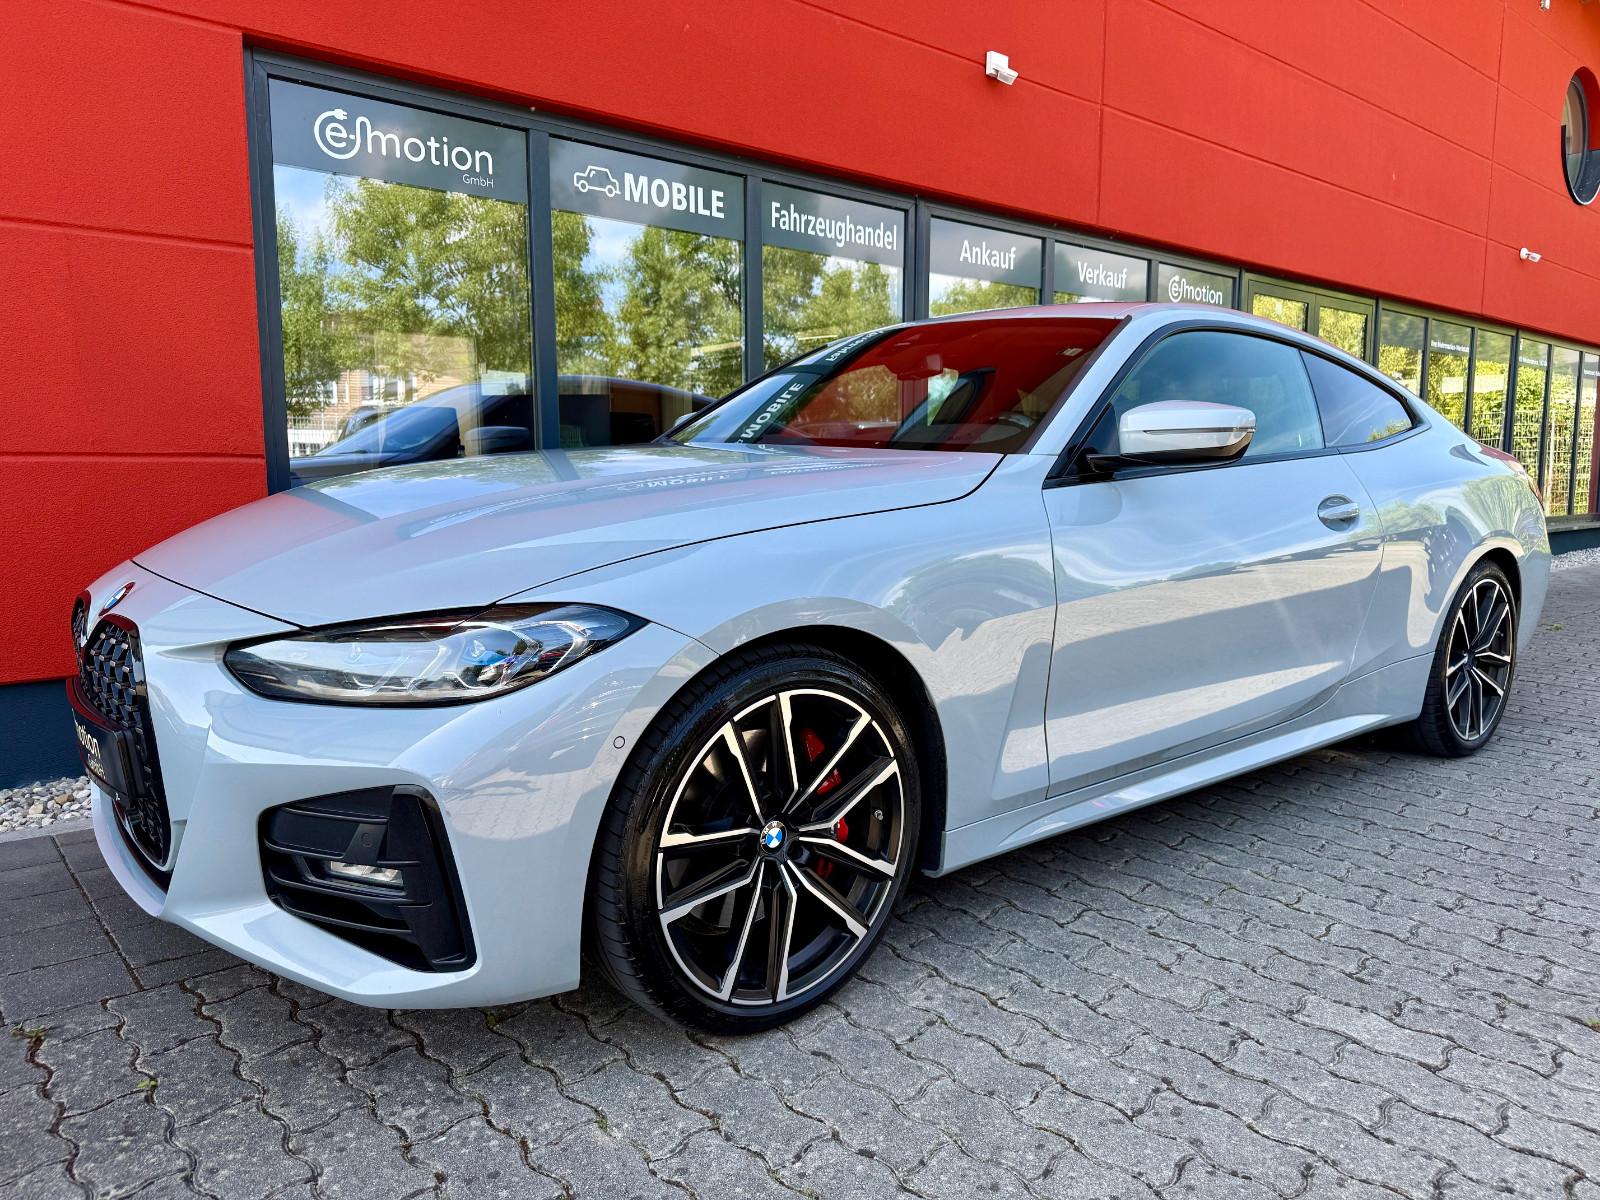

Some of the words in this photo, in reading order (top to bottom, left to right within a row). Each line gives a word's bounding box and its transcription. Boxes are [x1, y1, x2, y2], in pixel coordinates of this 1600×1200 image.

[462, 174, 494, 189] GmbH
[624, 172, 725, 219] MOBILE
[771, 201, 897, 250] Fahrzeughandel
[959, 239, 1017, 271] Ankauf
[1078, 260, 1128, 289] Verkauf
